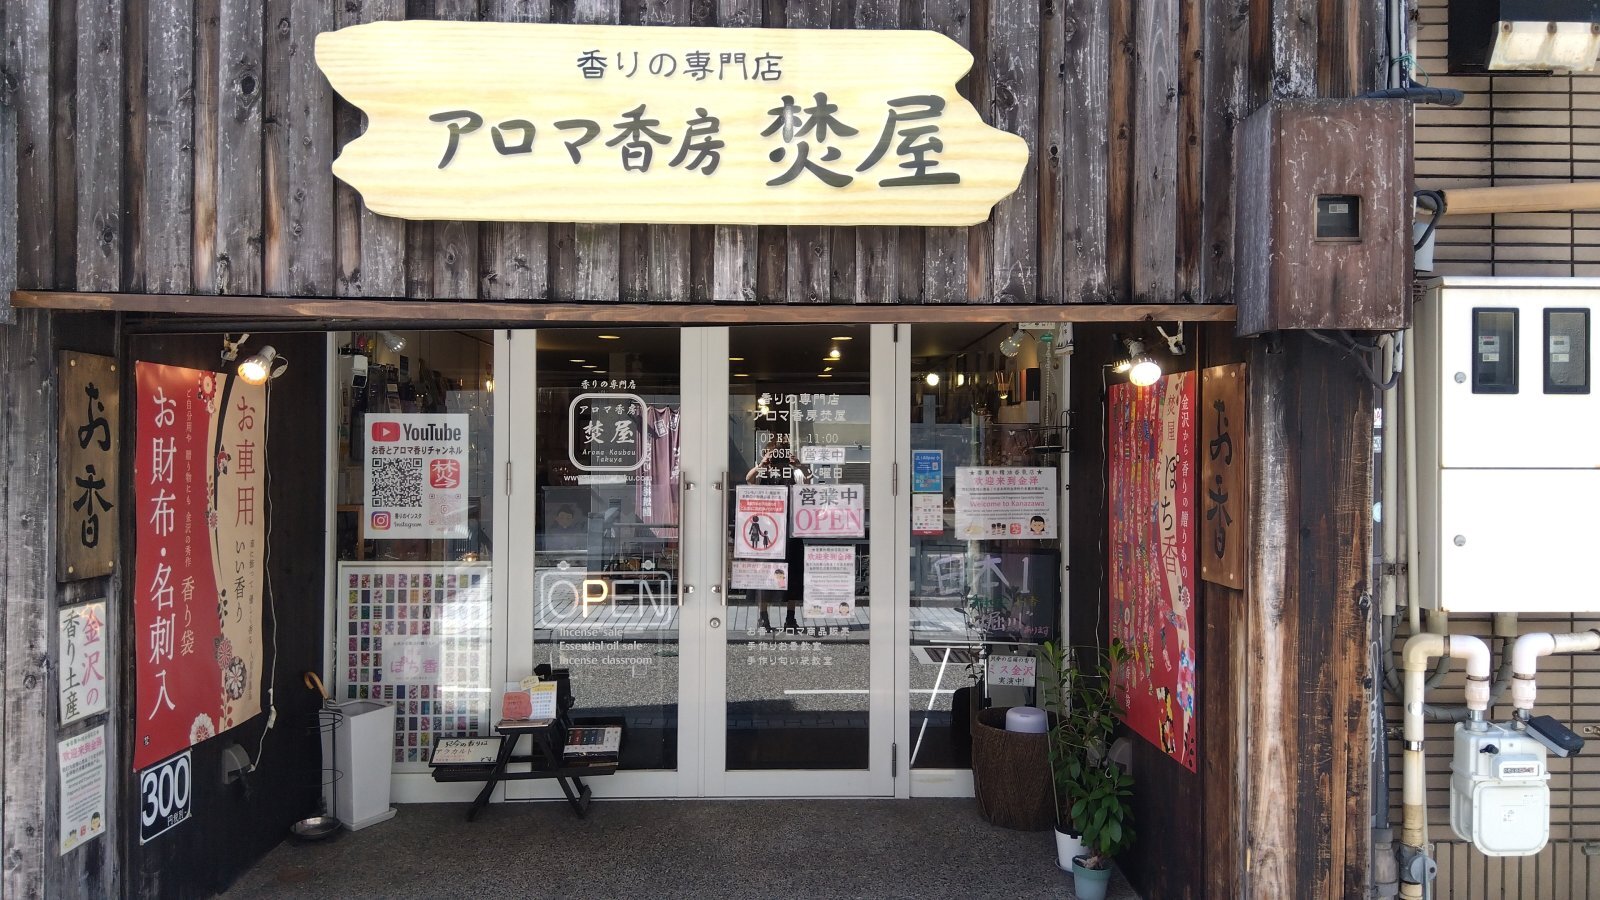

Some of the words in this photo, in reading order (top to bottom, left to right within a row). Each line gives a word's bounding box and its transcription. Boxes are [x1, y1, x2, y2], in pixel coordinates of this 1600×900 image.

[577, 50, 784, 81] 香りの専門店
[429, 103, 725, 175] アロマ香房
[760, 91, 961, 188] 焚屋
[581, 379, 636, 390] 香りの専門店
[761, 392, 840, 406] 香りの専門店
[579, 403, 637, 416] アロマ香房
[753, 409, 847, 422] アロマ香房焚屋
[403, 423, 462, 441] YouTube
[583, 419, 635, 444] 焚屋
[760, 433, 792, 443] OPEN
[807, 433, 839, 443] 11:00
[371, 446, 463, 456] お香とアロマ香りチャンネル
[582, 448, 604, 456] Aroma
[609, 448, 636, 456] Koubou
[803, 448, 843, 461] 営業中
[72, 382, 114, 549] お香
[236, 396, 256, 528] お車用
[756, 467, 792, 479] 定休日
[806, 467, 843, 479] 火曜日
[975, 476, 1039, 486] 欢迎来到金泽
[1206, 399, 1233, 560] お香
[1180, 393, 1190, 578] 金沢から香りの贈りもの
[799, 487, 858, 506] 営業中
[795, 508, 862, 531] OPEN
[149, 385, 178, 721] お財布・名刺入
[234, 540, 246, 624] いい香り
[547, 579, 666, 618] OPEN
[181, 575, 195, 657] 香り袋
[602, 628, 624, 637] sale
[746, 626, 850, 637] お香・アロマ商品販売
[560, 641, 604, 651] Essential
[607, 641, 619, 651] oil
[622, 641, 643, 651] sale
[747, 641, 821, 651] 手作りお香教室
[62, 608, 81, 721] 香り土産
[82, 607, 105, 707] 金沢の
[560, 656, 599, 665] Incense
[602, 655, 653, 665] classroom
[989, 664, 1035, 677] ミス金沢
[142, 756, 189, 828] 300
